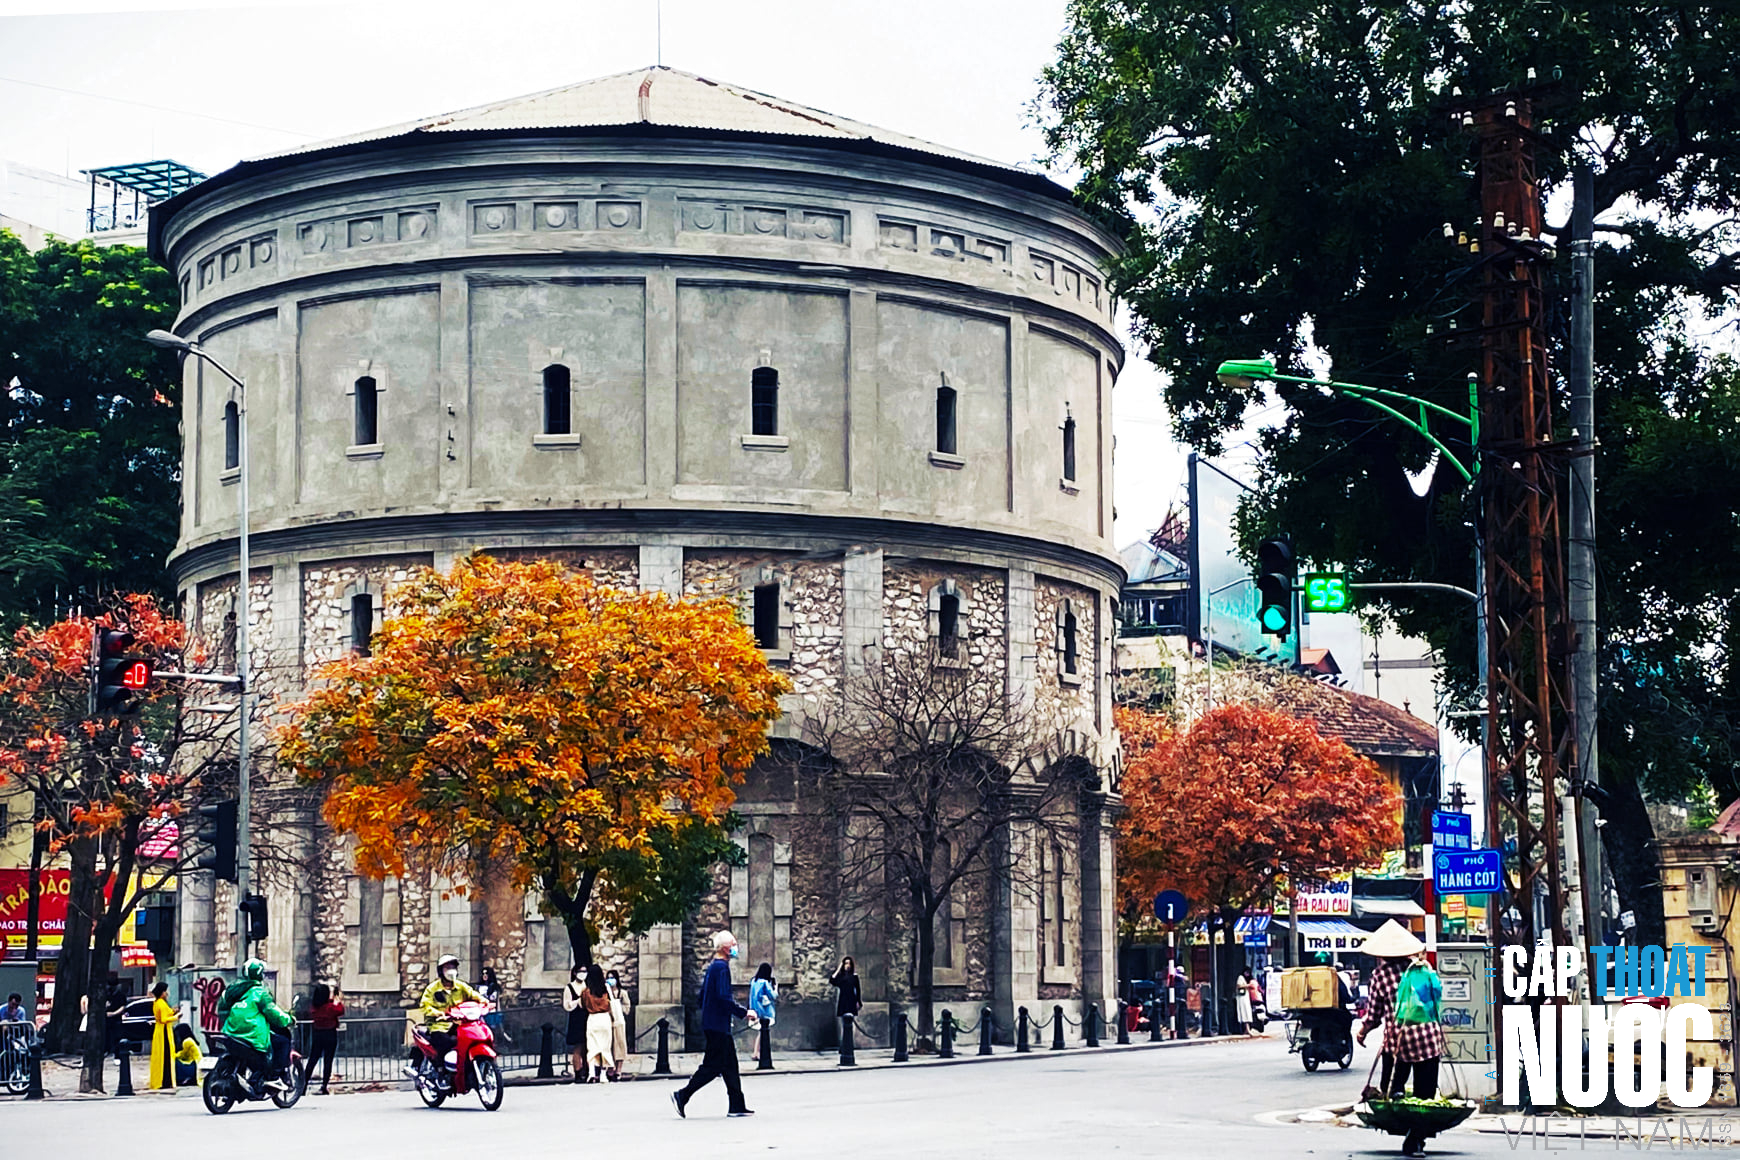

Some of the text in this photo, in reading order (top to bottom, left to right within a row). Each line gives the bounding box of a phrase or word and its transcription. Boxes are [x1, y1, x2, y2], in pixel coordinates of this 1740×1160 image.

[1310, 578, 1345, 607] 55
[1463, 854, 1485, 865] PHỐ
[1440, 867, 1496, 888] HÀNG CÓT
[1307, 936, 1331, 948] TRÀ
